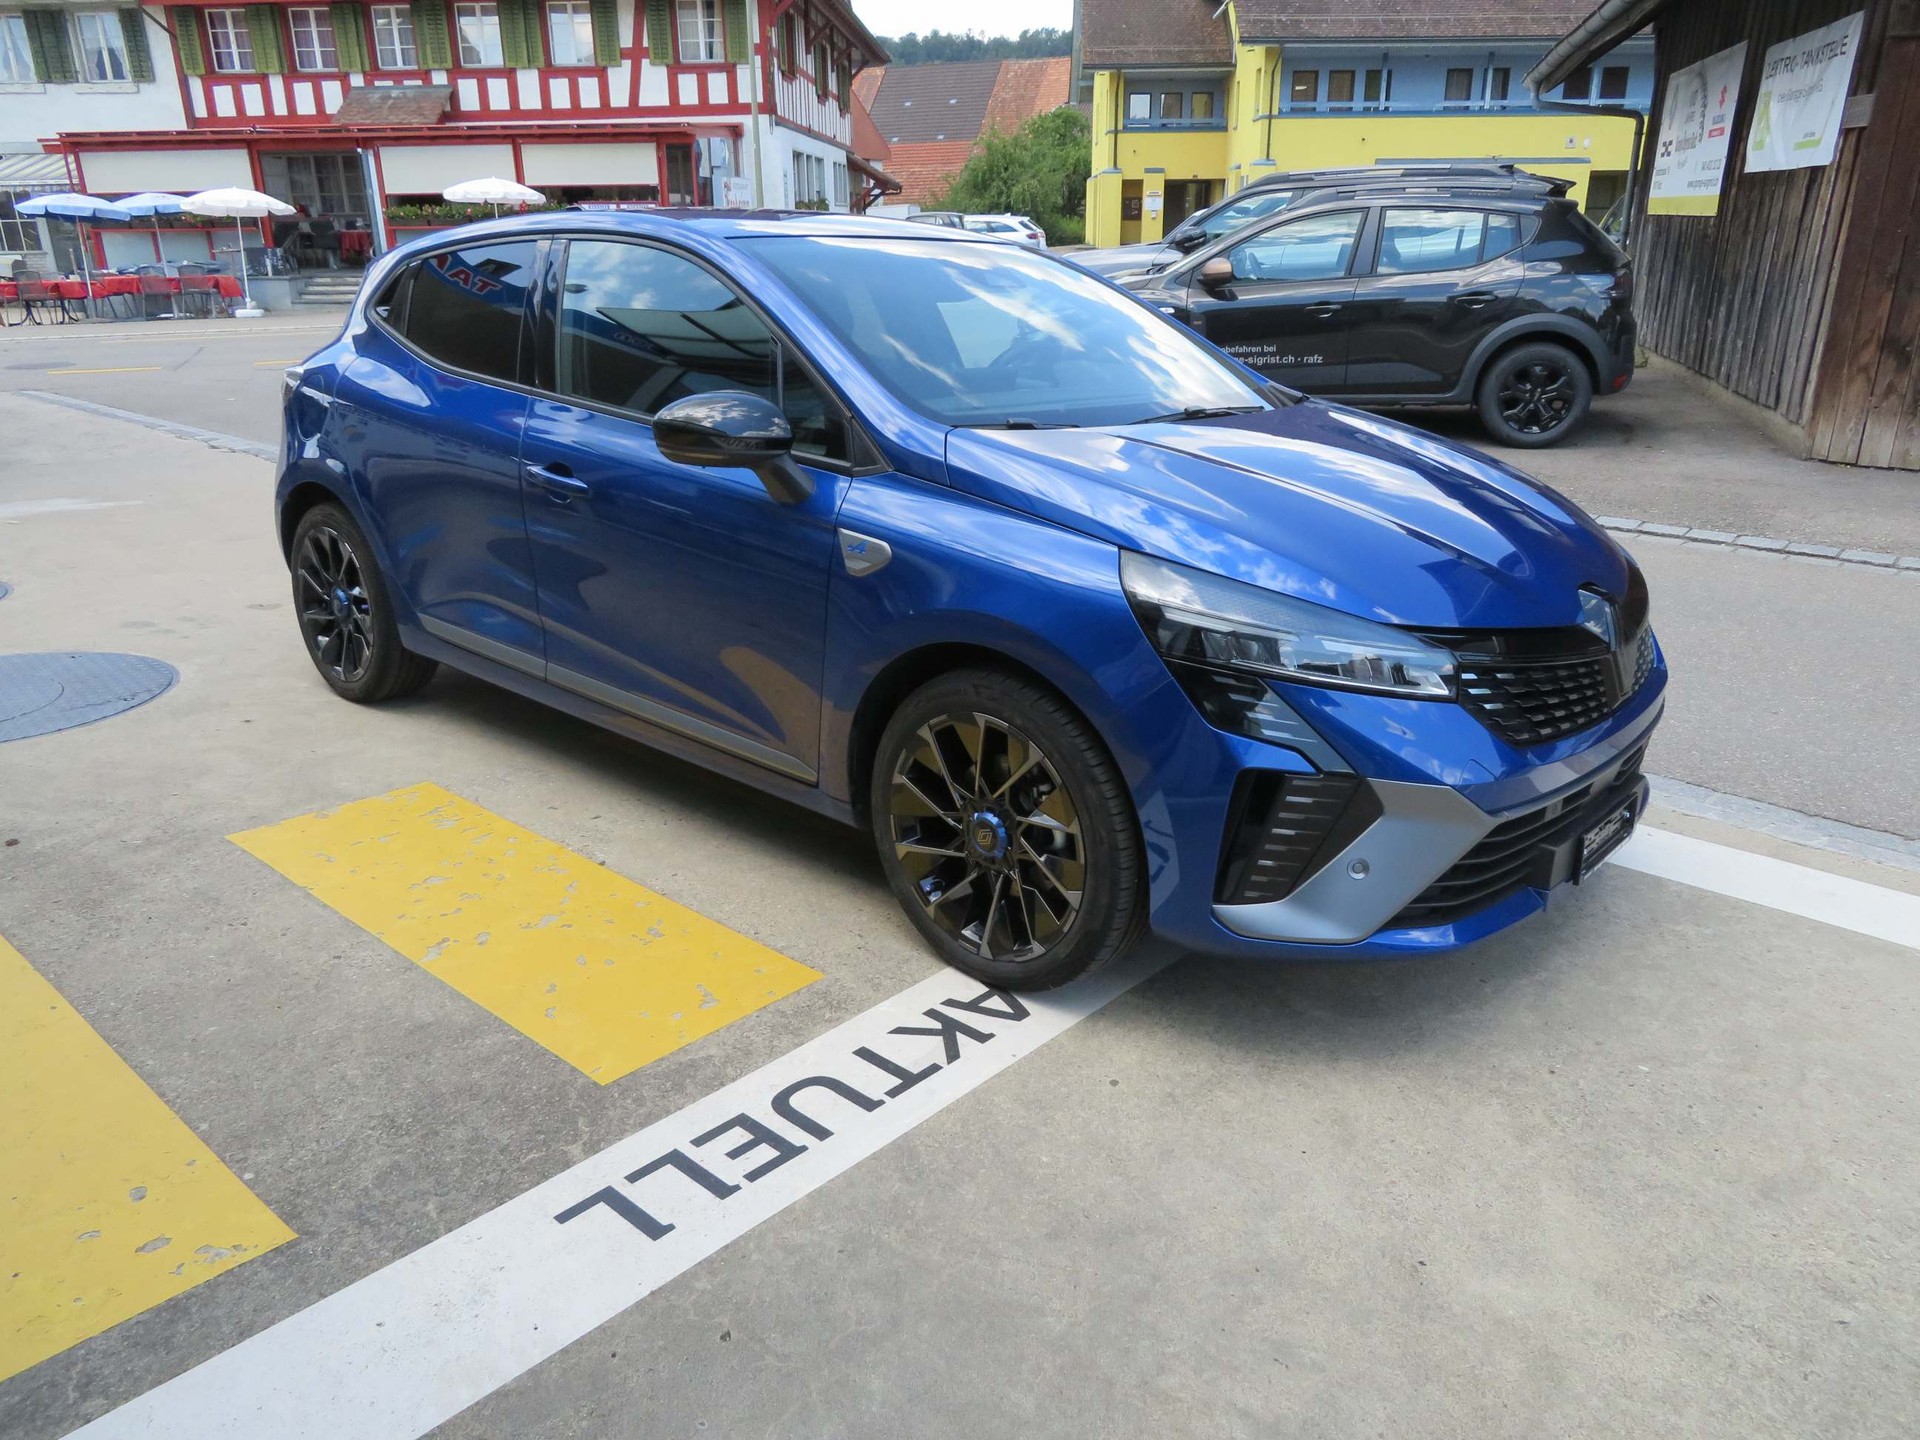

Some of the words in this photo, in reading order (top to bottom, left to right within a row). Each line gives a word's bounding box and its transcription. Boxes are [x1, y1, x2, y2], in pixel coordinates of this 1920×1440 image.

[1263, 344, 1277, 353] bei
[1303, 354, 1324, 364] rafz
[553, 980, 1031, 1242] AKTUELL
